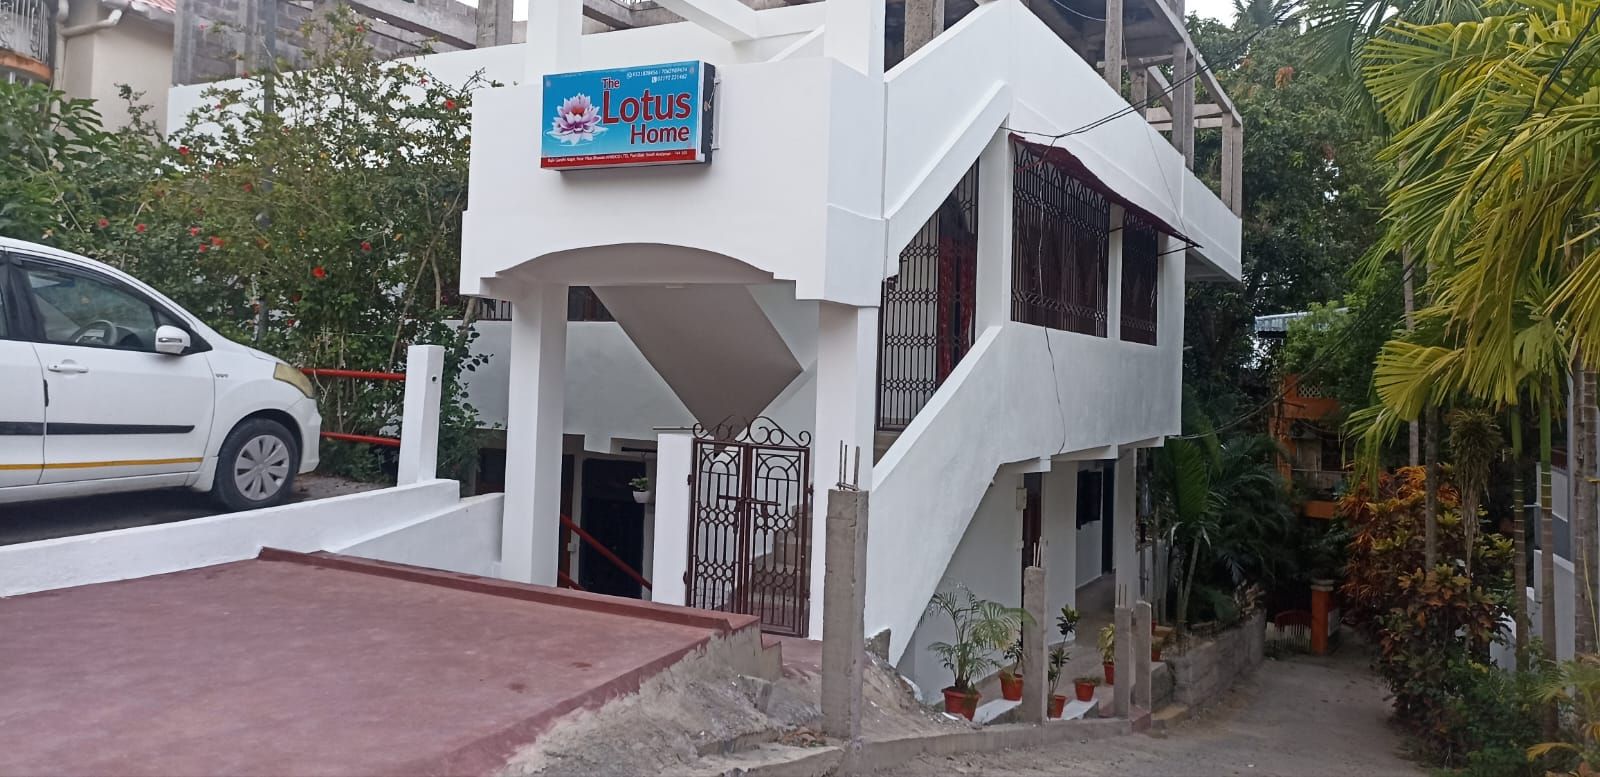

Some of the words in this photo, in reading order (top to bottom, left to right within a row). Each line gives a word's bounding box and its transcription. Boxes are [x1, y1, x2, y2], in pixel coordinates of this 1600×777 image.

[602, 77, 620, 90] The
[602, 89, 692, 125] Lotus
[630, 124, 690, 145] Home
